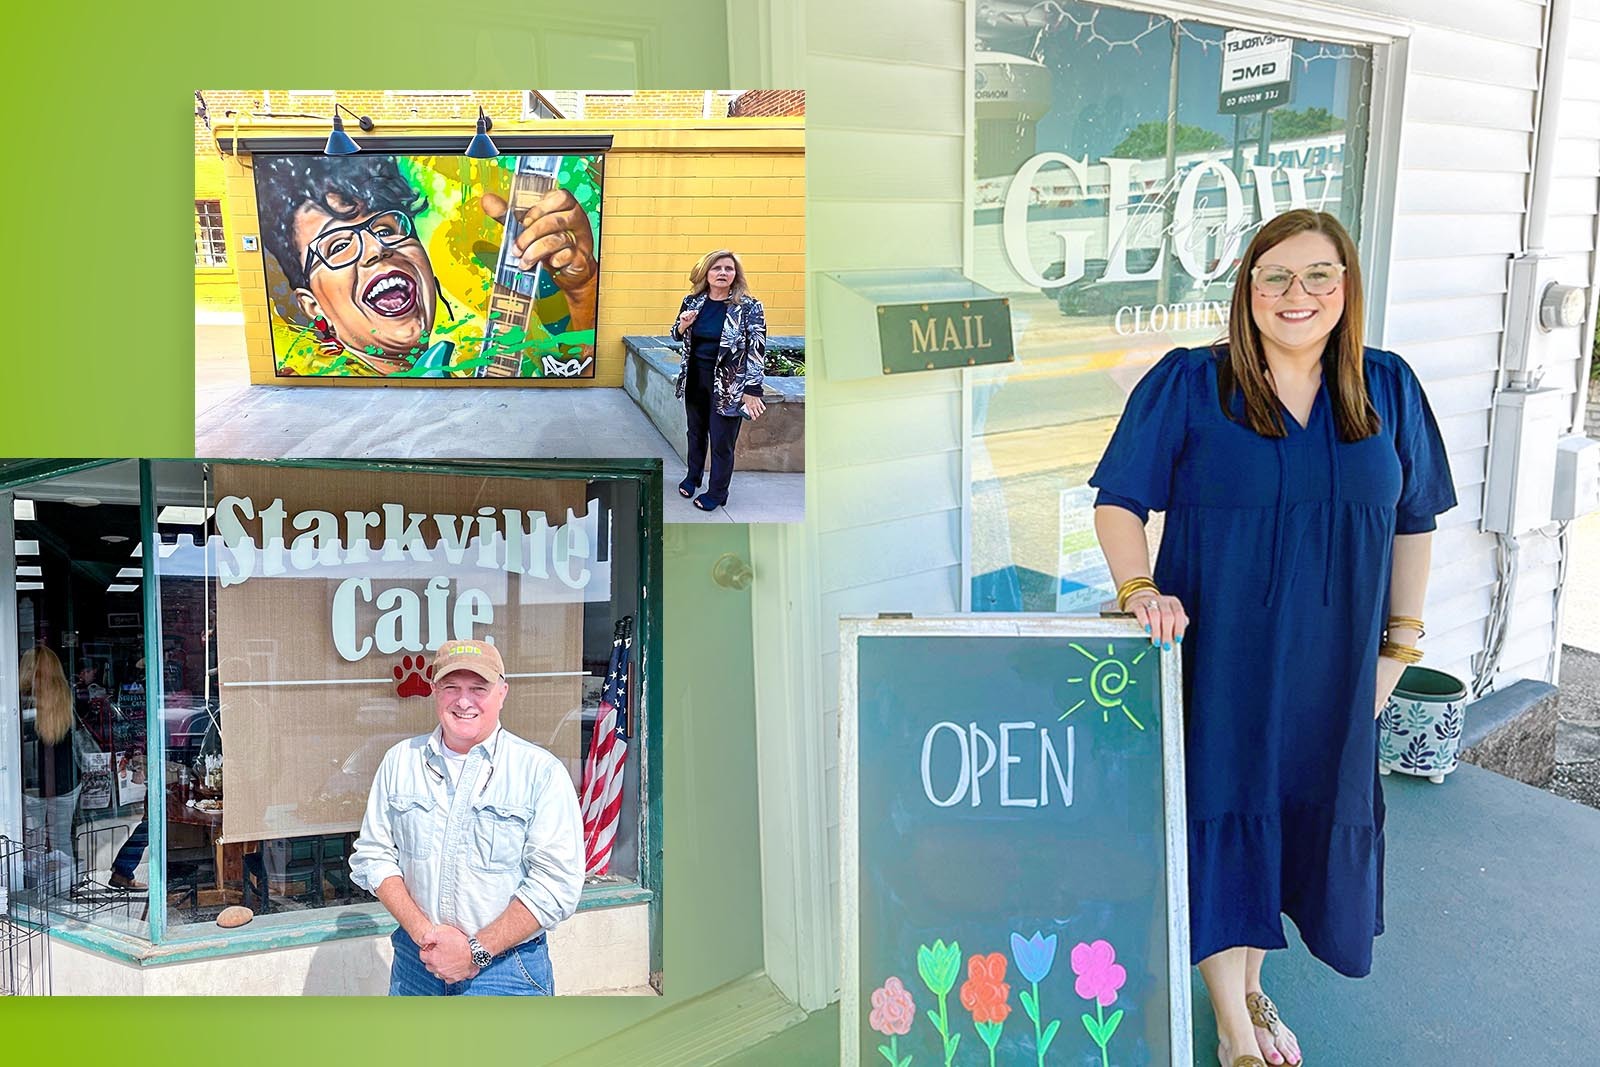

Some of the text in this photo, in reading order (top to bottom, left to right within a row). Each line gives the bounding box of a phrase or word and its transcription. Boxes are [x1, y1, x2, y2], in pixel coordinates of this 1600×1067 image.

[909, 314, 993, 353] MAIL
[1114, 301, 1230, 336] CLOTHIN
[215, 495, 591, 589] Starkville
[331, 576, 495, 662] Cafe
[920, 721, 1076, 808] OPEN
